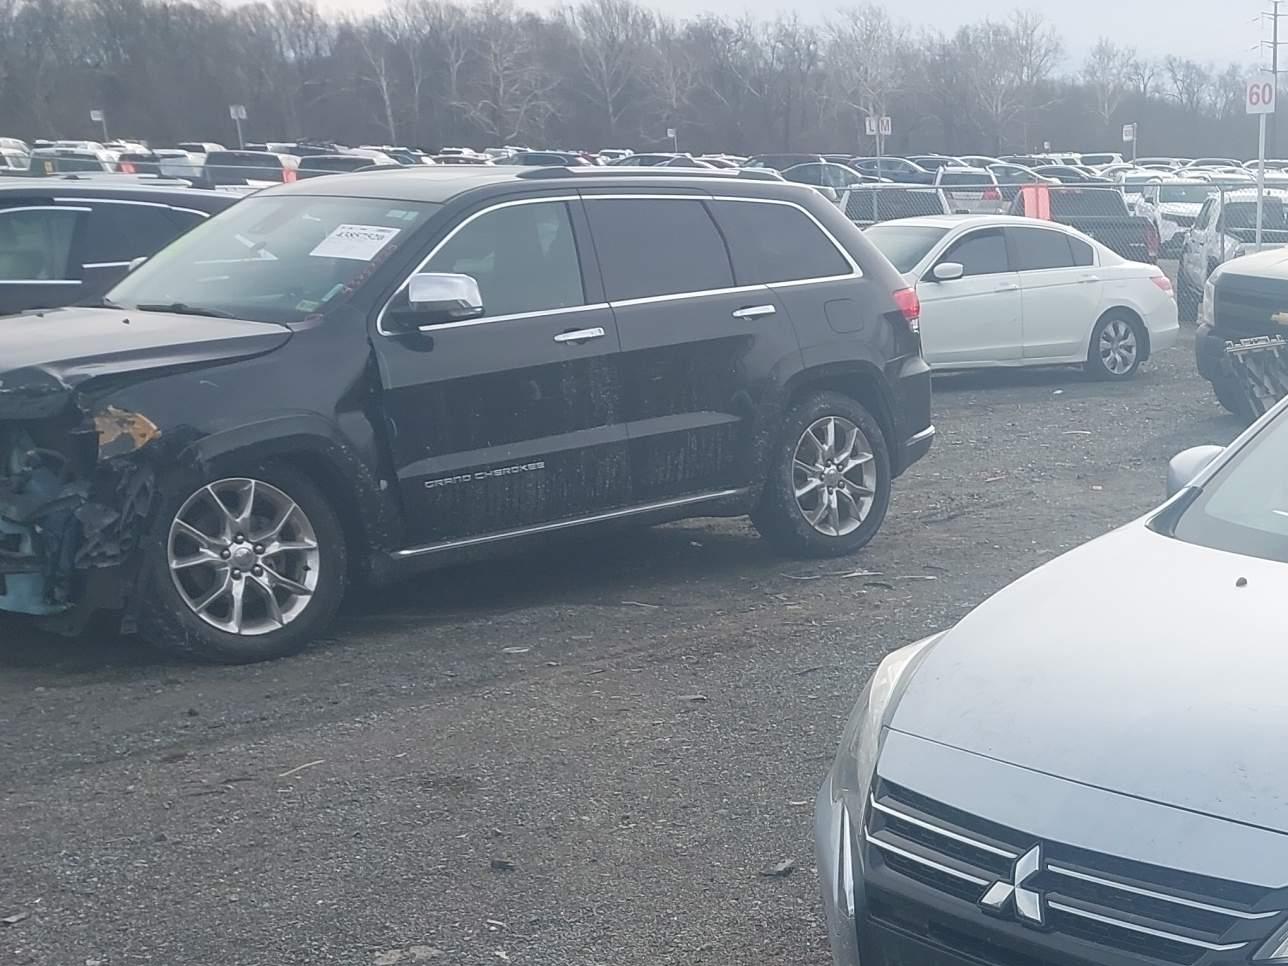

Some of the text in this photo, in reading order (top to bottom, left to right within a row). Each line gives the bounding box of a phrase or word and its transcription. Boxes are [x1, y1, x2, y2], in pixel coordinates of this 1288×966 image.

[1249, 83, 1272, 105] 60
[880, 119, 890, 132] M
[424, 461, 545, 489] GRAND CHEROKEE
